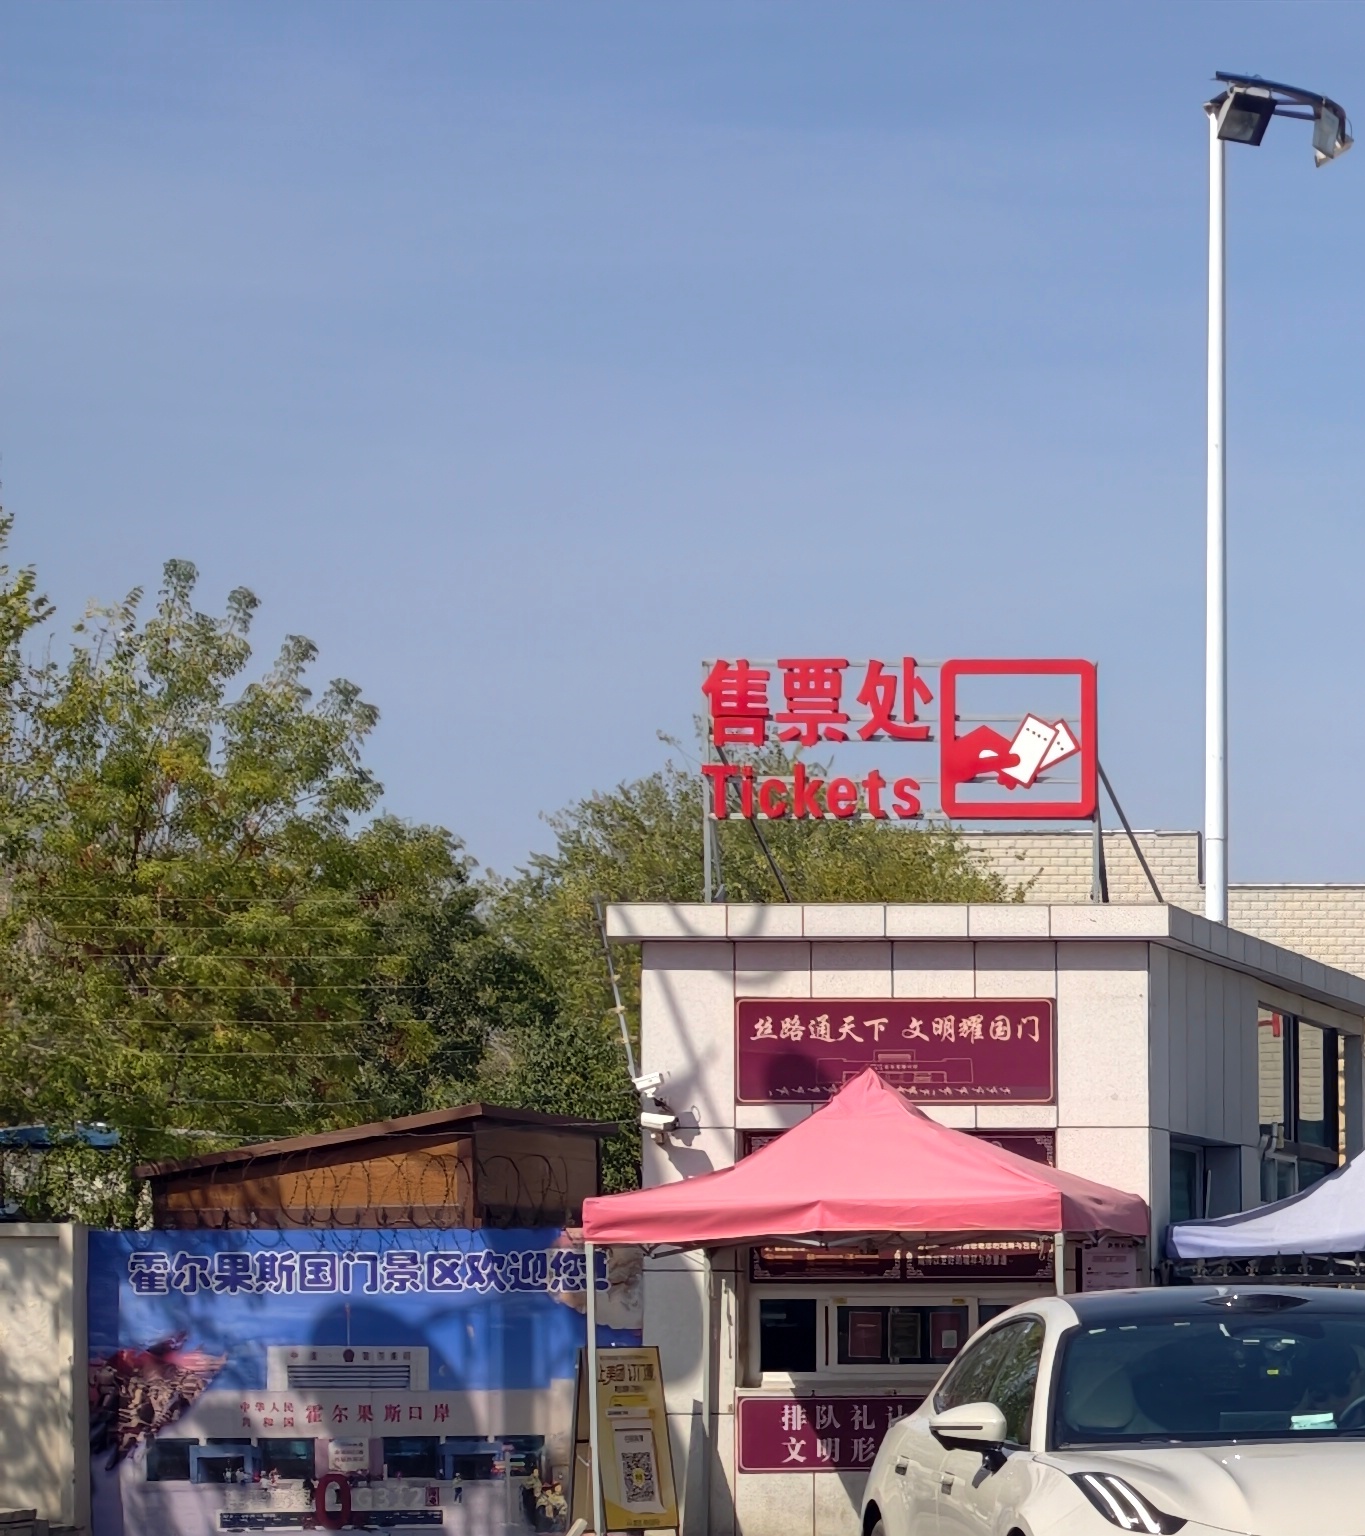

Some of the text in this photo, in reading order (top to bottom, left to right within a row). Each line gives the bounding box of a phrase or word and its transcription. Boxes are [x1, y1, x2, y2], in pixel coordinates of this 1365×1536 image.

[702, 657, 934, 747] 售票处
[702, 761, 921, 821] Tickets
[749, 1014, 1041, 1044] 丝路通天下 文明耀国门
[305, 1403, 450, 1424] 霍尔果斯口岸
